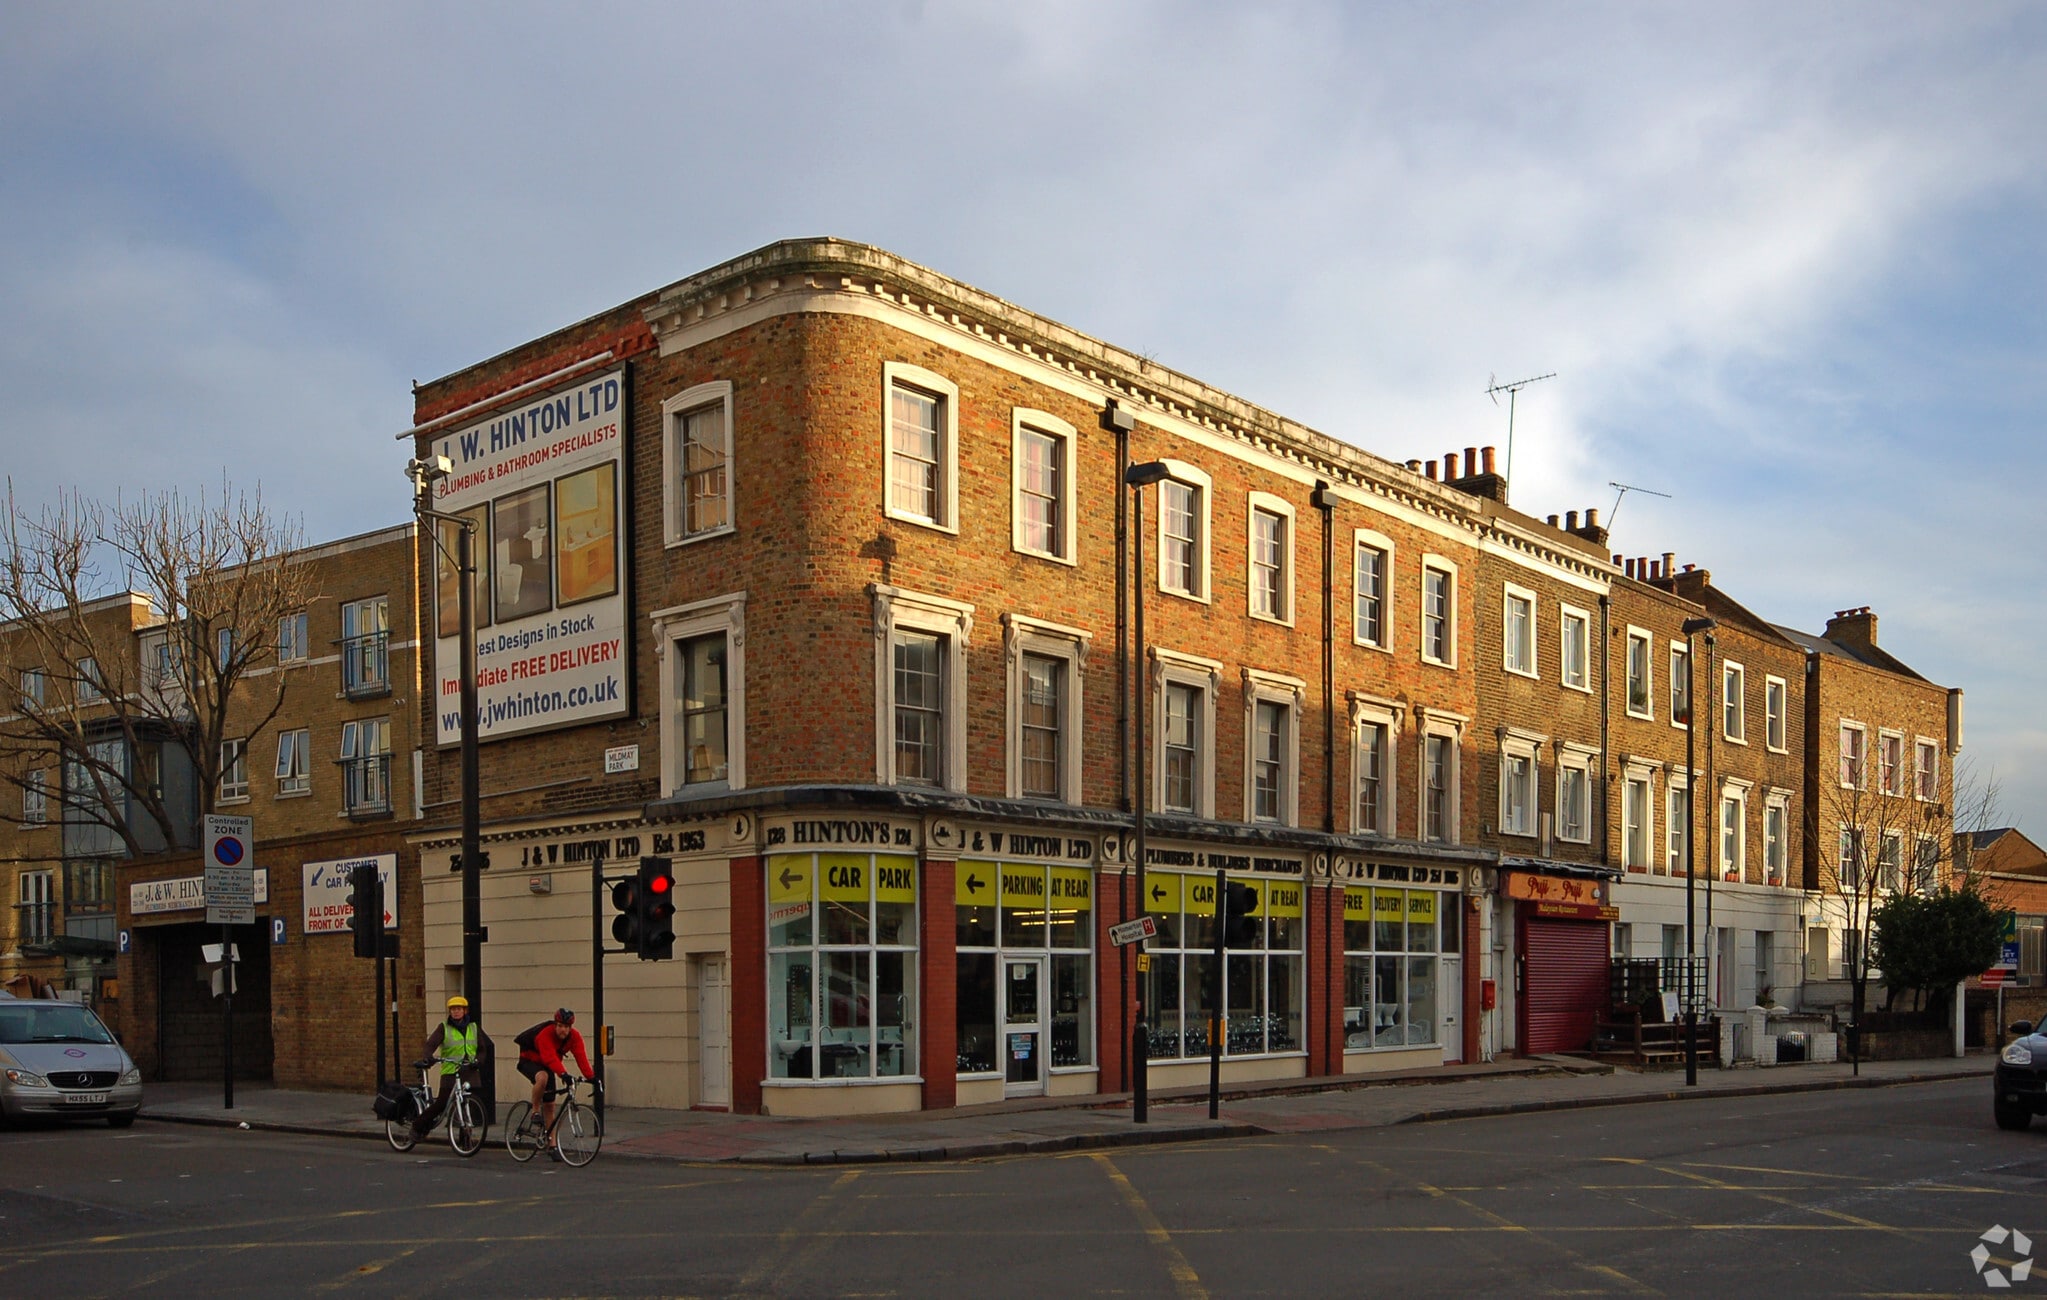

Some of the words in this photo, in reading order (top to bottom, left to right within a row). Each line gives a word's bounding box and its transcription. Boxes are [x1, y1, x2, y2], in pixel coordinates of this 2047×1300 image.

[460, 430, 485, 463] W.
[491, 396, 570, 454] HINTON
[577, 379, 619, 421] LTD
[440, 471, 486, 498] PLUMBING
[488, 468, 495, 480] &
[497, 446, 550, 478] BATHROOM
[552, 423, 617, 459] SPECIALISTS
[498, 629, 544, 651] Designs
[546, 622, 558, 641] in
[561, 614, 595, 637] Stock
[442, 667, 508, 696] Imdiate
[511, 655, 546, 681] FREE
[551, 639, 620, 673] DELIVERY
[608, 751, 634, 762] MILDMAY
[608, 762, 625, 770] PARK
[208, 817, 248, 825] Controlled
[214, 826, 243, 835] ZONE
[792, 820, 890, 844] HINTON'S
[521, 847, 528, 866] J
[532, 845, 542, 865] &
[546, 844, 558, 864] W
[563, 839, 612, 863] HINTON
[615, 836, 640, 858] LTD
[652, 832, 674, 855] Est
[678, 829, 706, 852] 1953
[958, 829, 966, 849] J
[972, 831, 985, 852] &
[989, 832, 1004, 852] W
[1009, 833, 1061, 857] HINTON
[1067, 839, 1092, 859] LTD
[1145, 848, 1195, 867] PLUMBERS
[1197, 853, 1205, 867] &
[1208, 853, 1250, 870] BUILDERS
[1253, 857, 1303, 873] MERCHANTS
[1347, 861, 1353, 877] J
[1355, 862, 1364, 878] &
[326, 877, 342, 888] CAR
[828, 866, 861, 888] CAR
[879, 868, 911, 889] PARK
[1003, 874, 1043, 896] PARKING
[1051, 878, 1063, 897] AT
[1065, 878, 1089, 898] REAR
[180, 879, 204, 899] HINT
[1193, 885, 1214, 903] CAR
[1270, 889, 1279, 906] AT
[1281, 890, 1298, 907] REAR
[309, 906, 321, 918] ALL
[1344, 894, 1363, 910] FREE
[1375, 896, 1401, 912] DELIVERY
[1408, 898, 1431, 913] SERVICE
[274, 919, 284, 943] P
[309, 919, 332, 930] FRONT
[335, 918, 345, 929] OF
[1118, 922, 1142, 933] Homerton
[1121, 930, 1143, 940] Hospital
[120, 931, 129, 953] P
